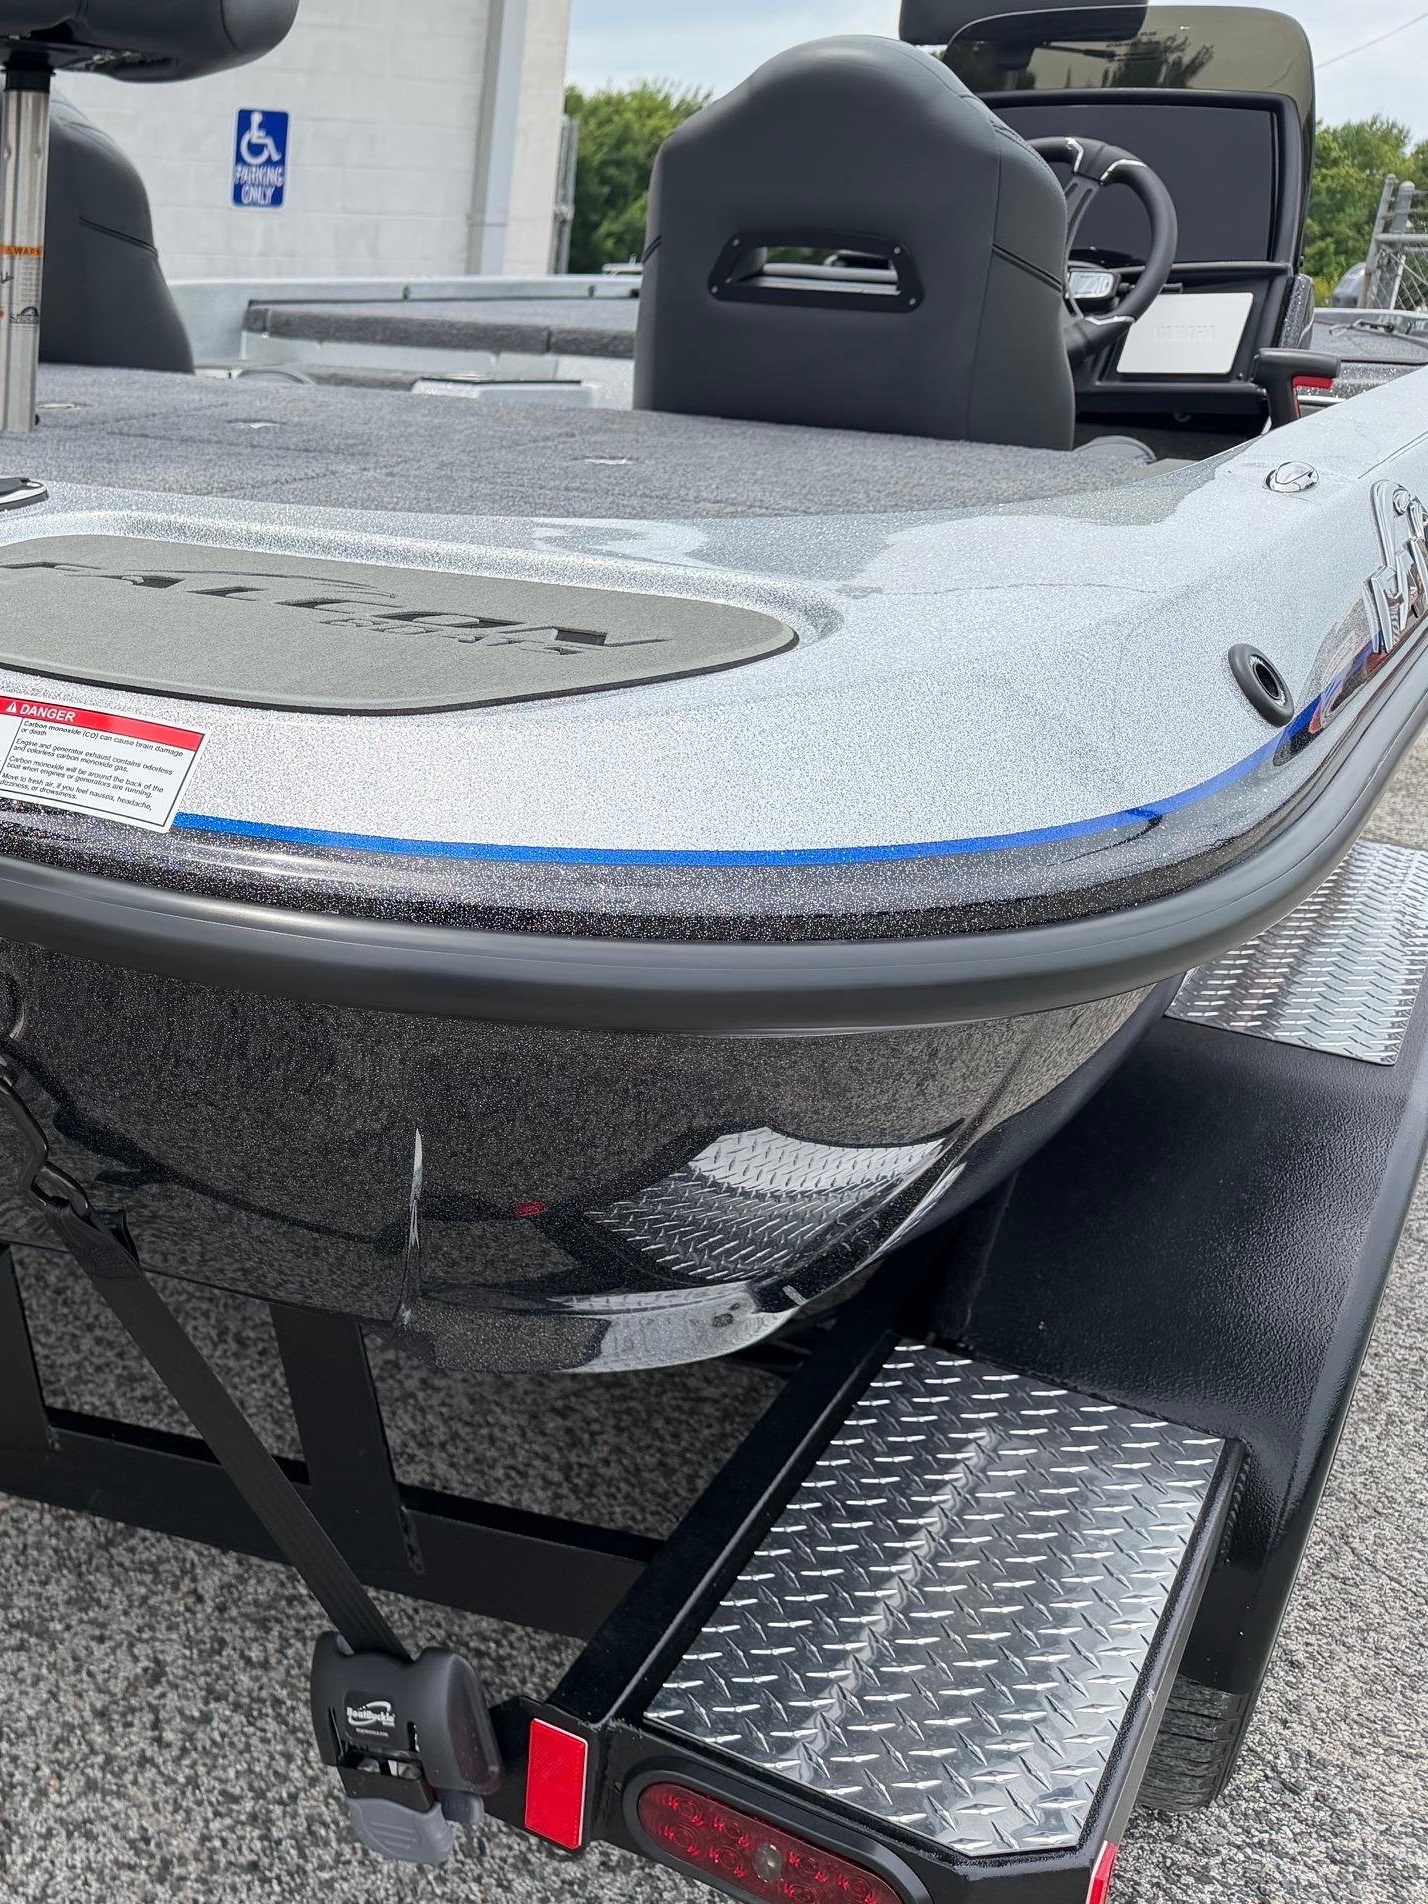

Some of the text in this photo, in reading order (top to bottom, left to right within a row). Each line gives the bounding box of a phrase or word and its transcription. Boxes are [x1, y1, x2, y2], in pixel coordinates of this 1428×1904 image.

[235, 163, 284, 188] PARKING
[241, 184, 276, 205] ONLY
[20, 704, 75, 722] DANGER
[23, 720, 48, 729] Carbon
[48, 725, 82, 735] monoxide
[82, 730, 99, 739] (CO)
[113, 737, 134, 746] cause
[135, 741, 154, 750] brain
[154, 745, 184, 757] damage
[28, 728, 47, 736] death
[15, 738, 38, 749] Engine
[51, 745, 84, 756] generator
[84, 751, 112, 761] exhaust
[112, 757, 142, 767] contains
[142, 763, 173, 775] odorless
[26, 747, 55, 757] colorless
[56, 753, 79, 761] carbon
[80, 757, 114, 769] monoxide
[113, 765, 129, 773] gas.
[8, 755, 32, 765] Carbon
[32, 760, 65, 771] monoxide
[87, 771, 112, 781] around
[112, 775, 125, 783] the
[124, 778, 142, 787] back
[152, 785, 164, 793] the
[22, 765, 39, 773] when
[39, 768, 66, 778] engines
[74, 775, 111, 788] generators
[124, 786, 153, 798] running.
[0, 779, 30, 790] dizziness,
[39, 786, 78, 799] drowsiness.
[1, 772, 19, 780] Move
[27, 777, 44, 785] fresh
[75, 786, 89, 794] feel
[88, 790, 115, 802] nausea,
[116, 796, 153, 811] headache,
[346, 1705, 396, 1722] BoatBuckle
